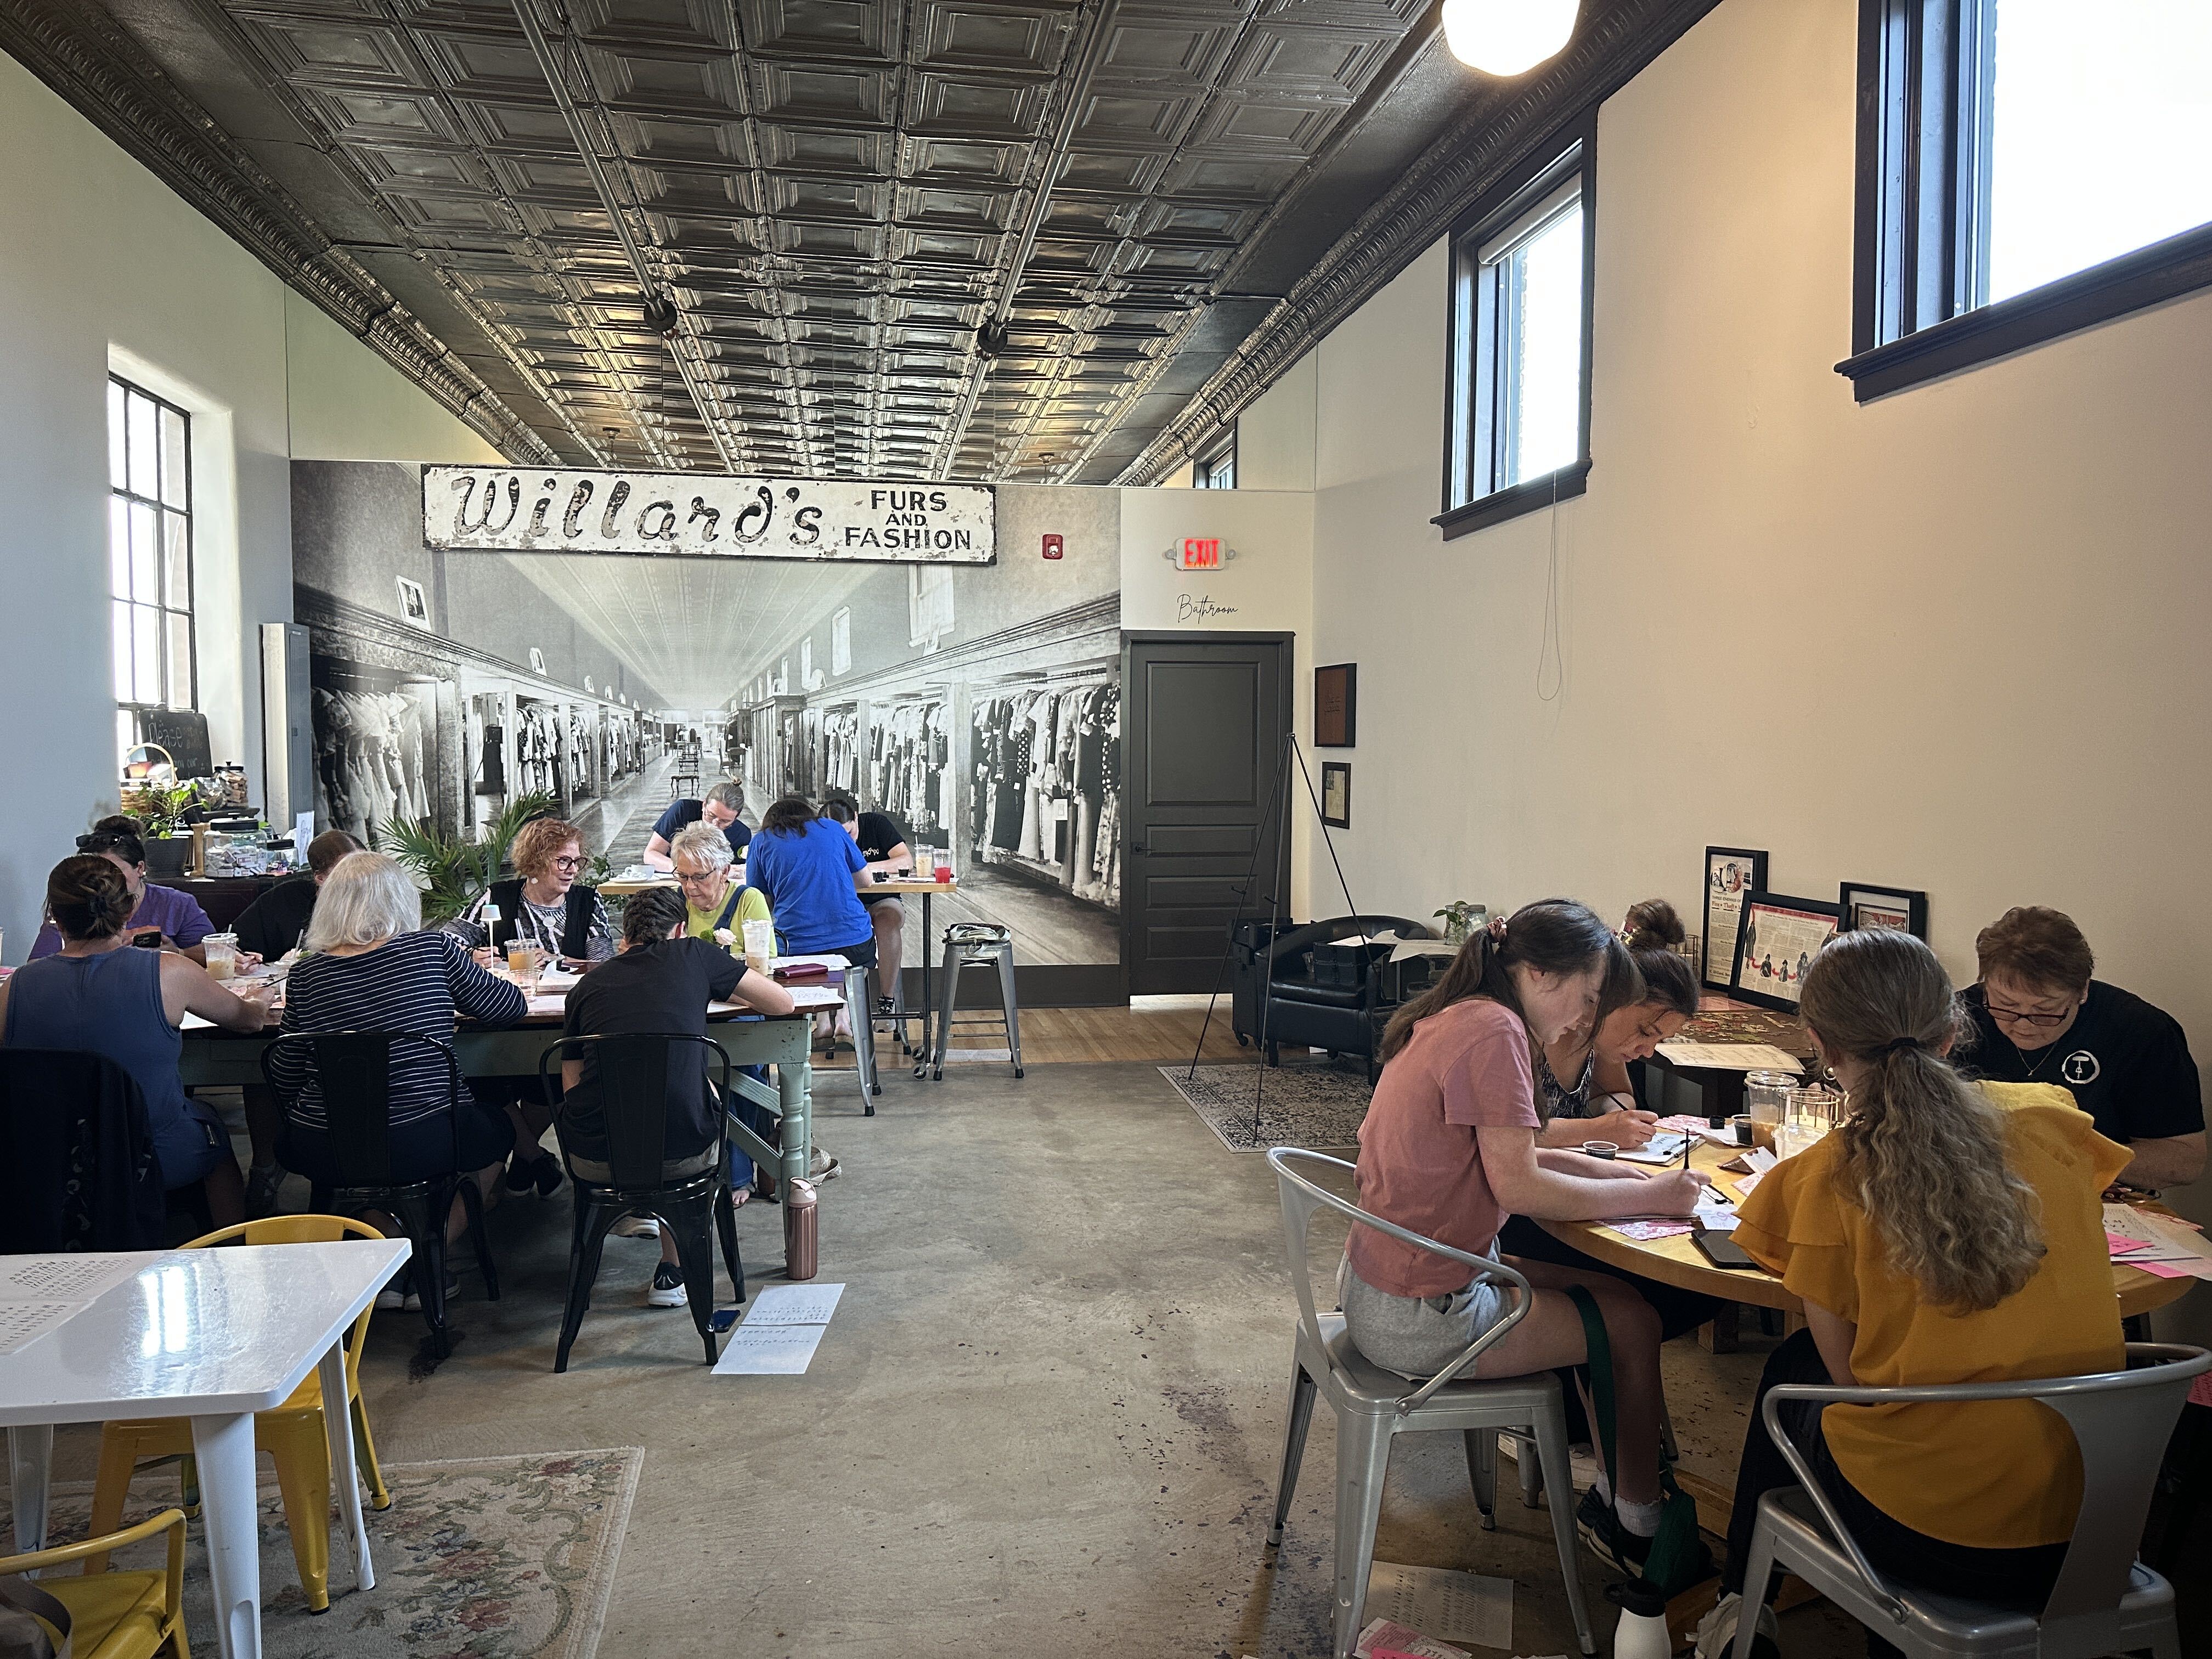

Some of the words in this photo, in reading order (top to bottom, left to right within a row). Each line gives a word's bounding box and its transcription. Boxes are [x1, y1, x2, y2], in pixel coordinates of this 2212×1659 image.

[451, 476, 822, 546] Willard's
[871, 489, 947, 511] FURS
[885, 513, 927, 527] AND
[845, 527, 970, 550] FASHION
[1184, 539, 1221, 567] EXIT
[1177, 594, 1239, 624] Bathroom
[148, 721, 183, 748] Please
